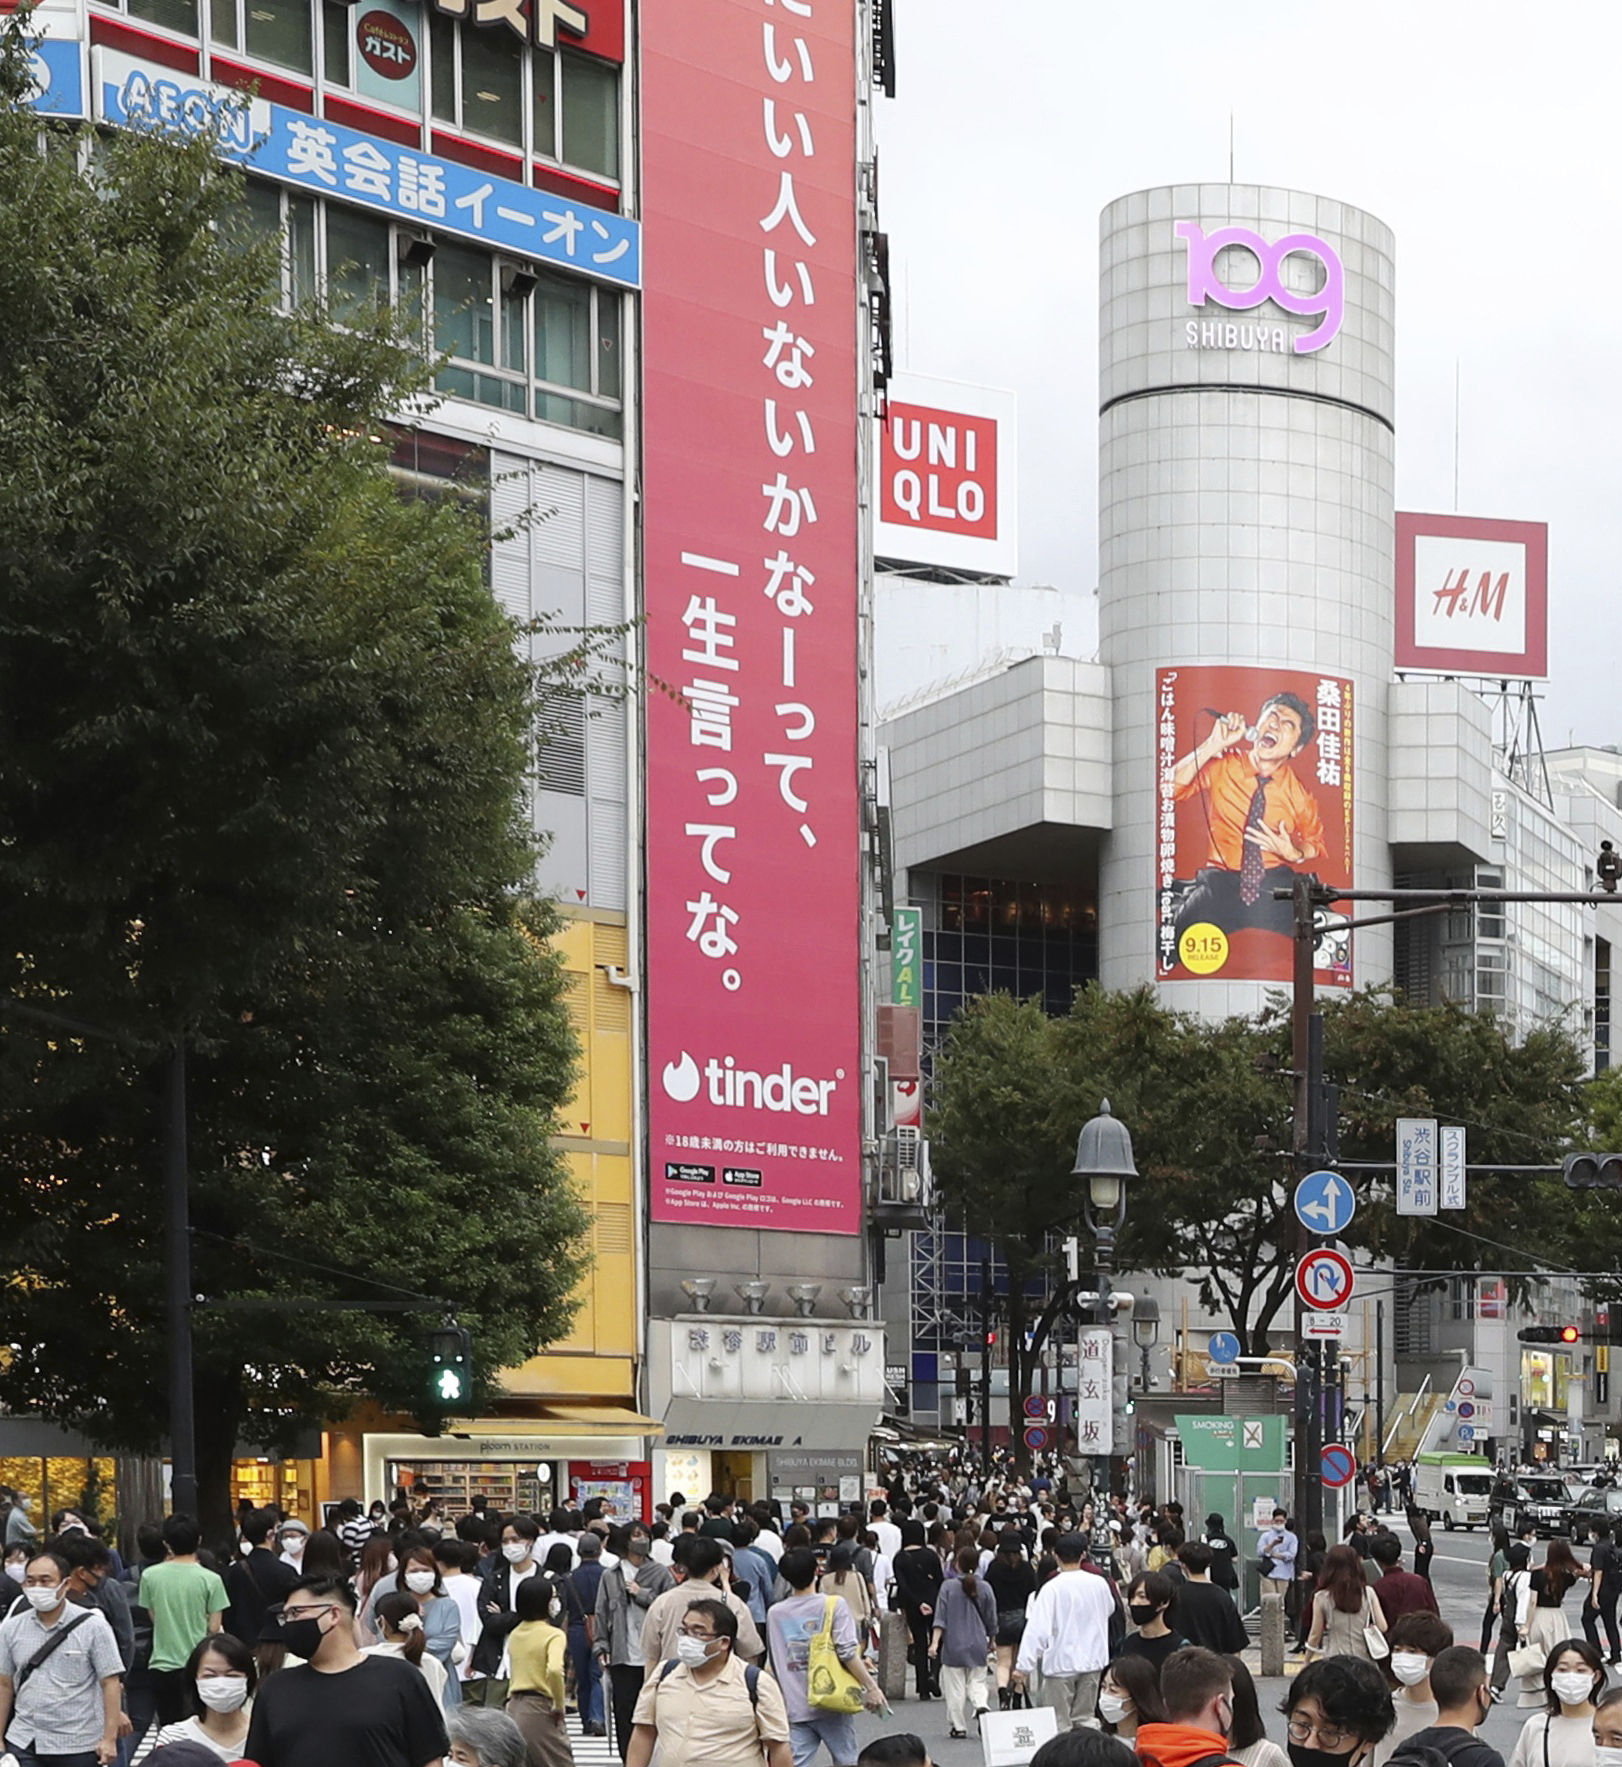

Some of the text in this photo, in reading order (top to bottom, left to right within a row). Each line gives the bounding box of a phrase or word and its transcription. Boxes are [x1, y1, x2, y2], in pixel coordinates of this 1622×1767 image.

[364, 36, 413, 64] ガスト
[287, 120, 630, 265] 英会話 イーオン
[1175, 219, 1344, 355] 109
[1185, 321, 1286, 354] SHIBUYA
[760, 0, 818, 847] いい人いないかなーって、
[893, 418, 976, 473] UNI
[893, 472, 985, 524] QLO
[1433, 567, 1510, 624] H&M
[1316, 679, 1341, 787] 桑田佳祐
[681, 551, 742, 992] 一生言ってな。
[1185, 937, 1221, 953] 9.15
[705, 1056, 836, 1116] tinder
[1402, 1138, 1413, 1176] Shibuya
[1413, 1127, 1432, 1207] 渋谷駅前
[1446, 1131, 1460, 1206] スクランブル式
[688, 1327, 873, 1355] 渋谷駅前ビル
[1330, 1315, 1342, 1326] 20
[1080, 1338, 1101, 1444] 道玄坂
[481, 1440, 551, 1454] ploom STATION
[1192, 1420, 1235, 1431] SMOKING
